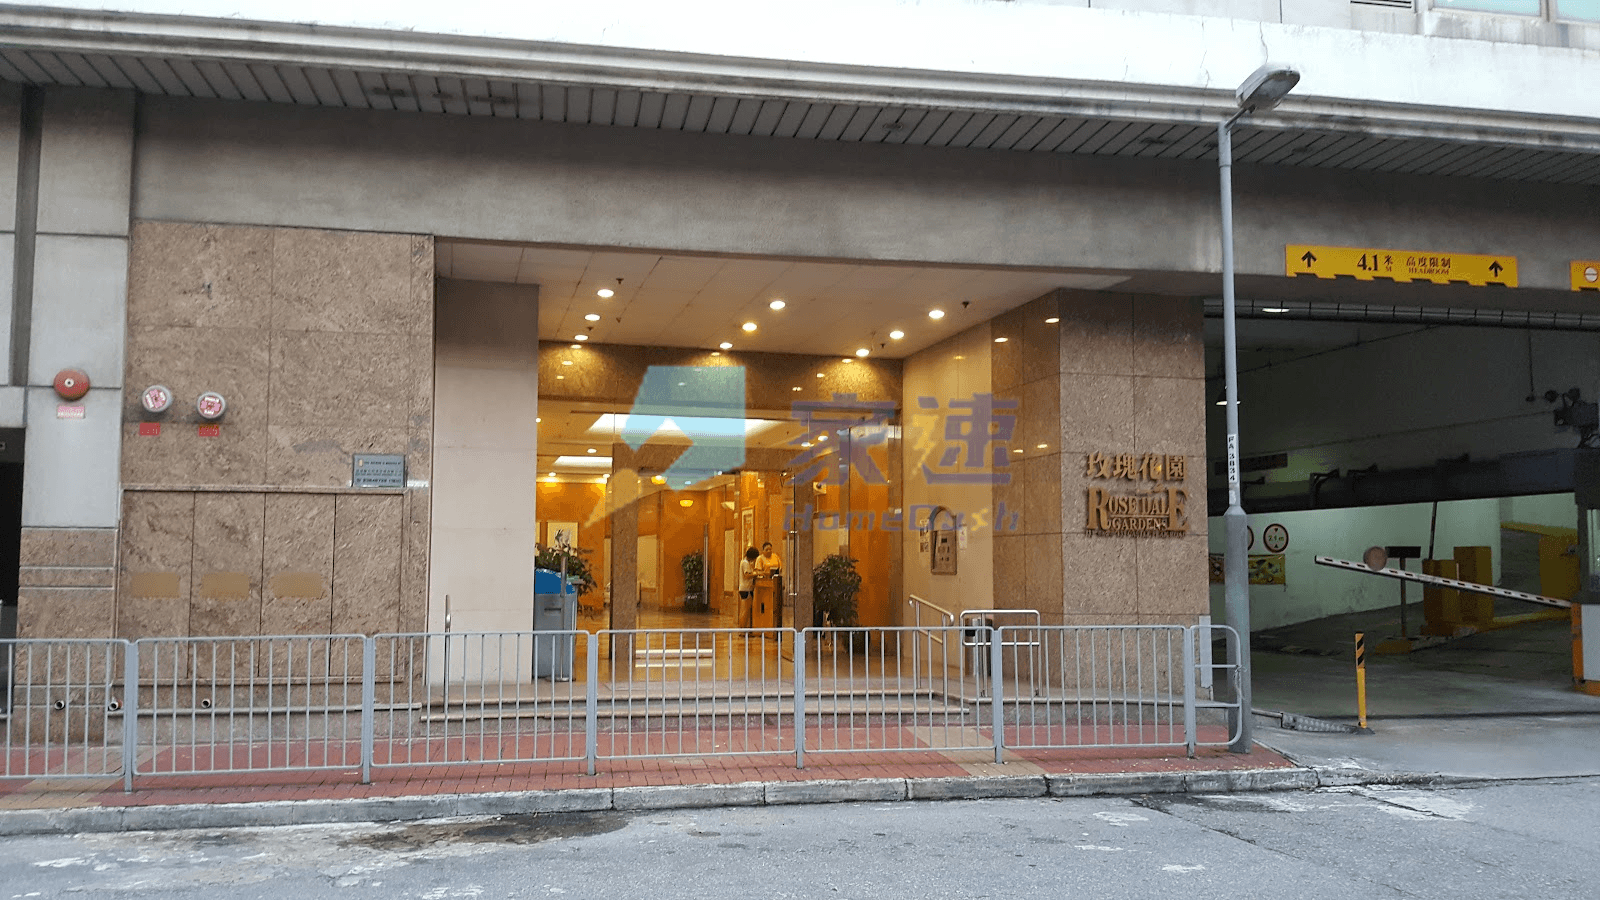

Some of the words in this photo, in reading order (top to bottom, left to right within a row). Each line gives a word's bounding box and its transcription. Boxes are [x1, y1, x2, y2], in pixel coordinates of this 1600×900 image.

[1357, 253, 1378, 271] 4.1
[1406, 255, 1451, 268] 高度限制
[1086, 451, 1187, 481] 玫瑰花園
[1087, 486, 1189, 532] ROSEDALE
[1111, 517, 1168, 531] GARDENS
